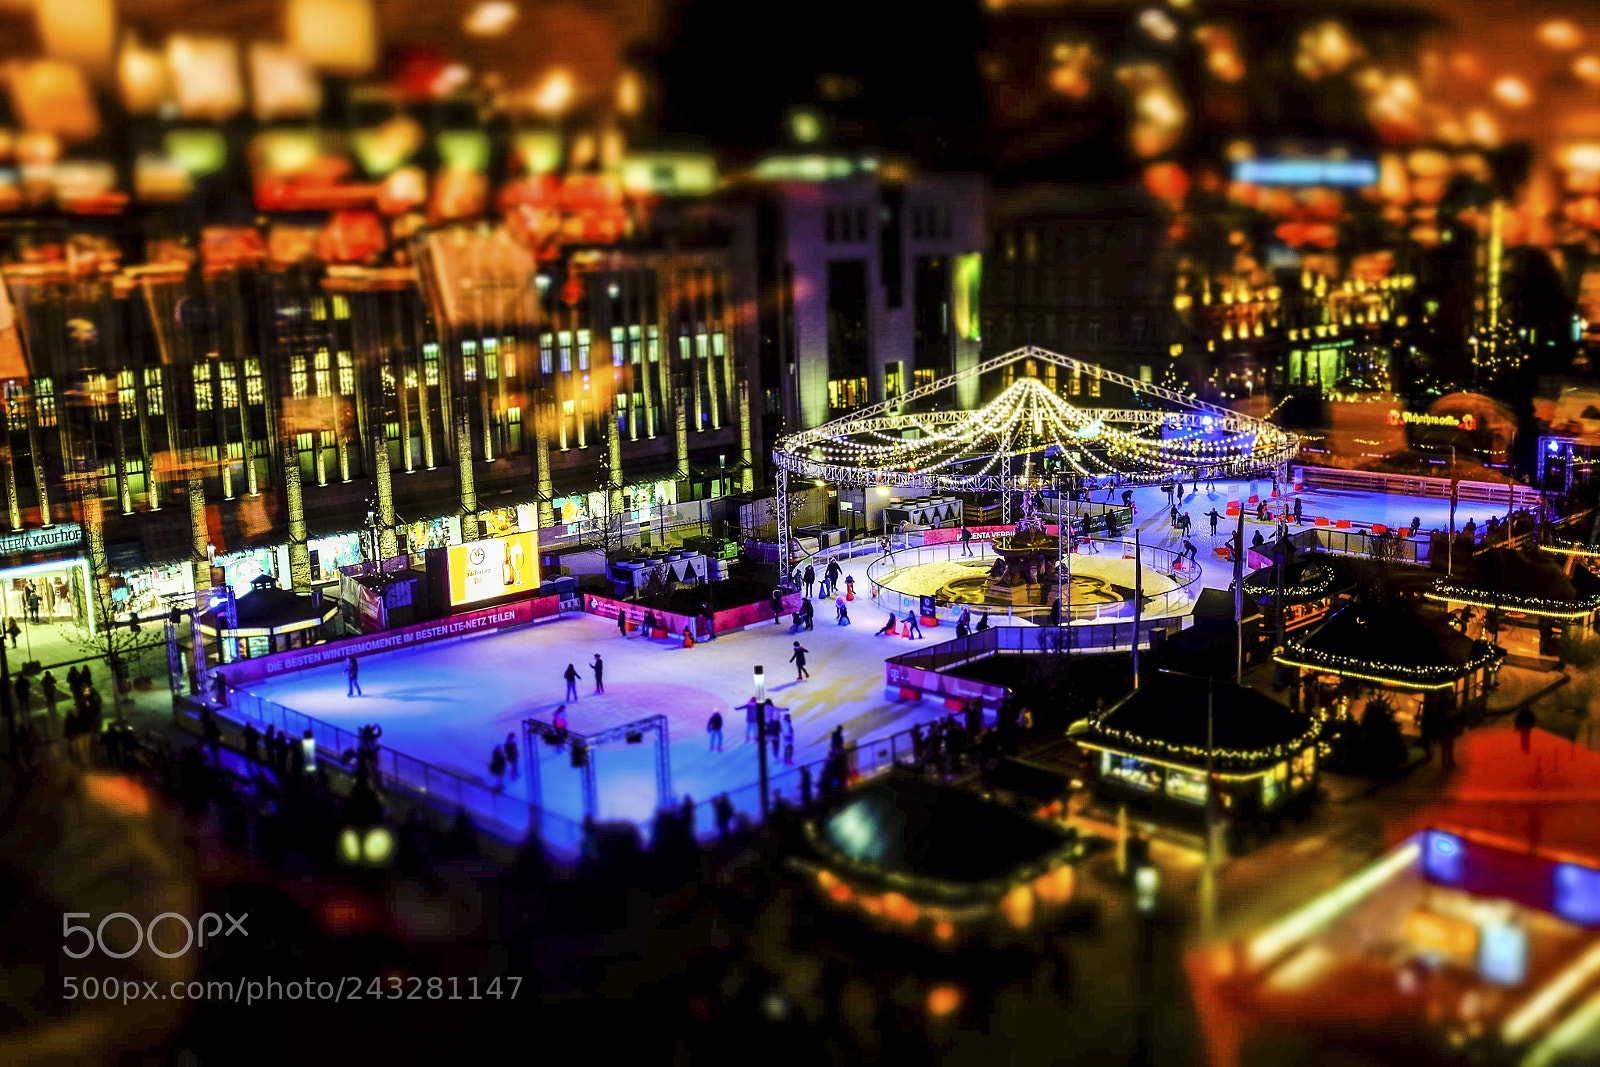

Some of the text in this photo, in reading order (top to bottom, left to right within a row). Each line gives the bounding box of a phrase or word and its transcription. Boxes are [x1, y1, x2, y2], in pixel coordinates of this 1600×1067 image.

[267, 610, 516, 673] DIE BESTEN WINTERMOMENTE IM BESTEN LTE-NETZ TEILEN
